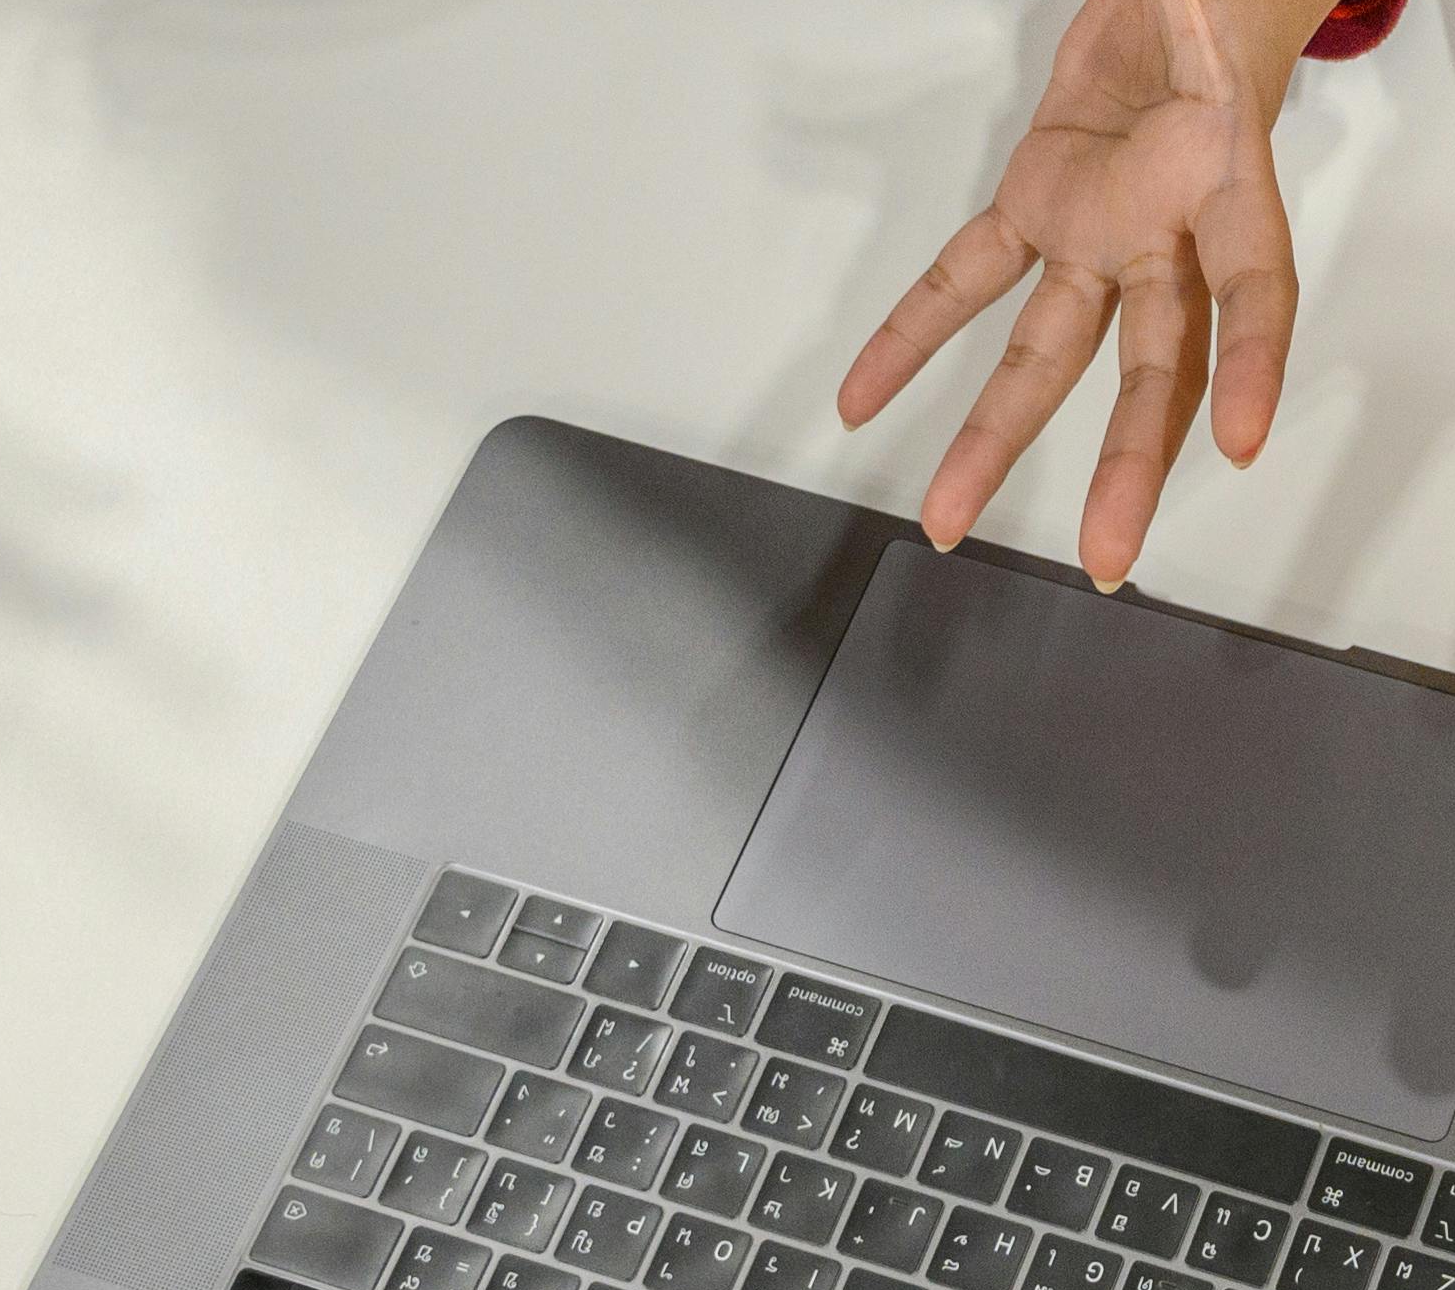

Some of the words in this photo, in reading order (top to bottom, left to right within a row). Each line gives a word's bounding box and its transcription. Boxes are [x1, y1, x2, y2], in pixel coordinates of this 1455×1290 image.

[705, 960, 756, 984] option
[786, 985, 864, 1017] command
[594, 1017, 616, 1038] ฝ
[769, 1070, 790, 1089] ม
[516, 1083, 530, 1100] ง
[857, 1096, 875, 1116] ท
[602, 1110, 616, 1129] ว
[892, 1108, 917, 1132] M
[411, 1144, 429, 1163] ล
[689, 1138, 709, 1157] ส
[982, 1136, 1006, 1160] N
[736, 1150, 750, 1173] L
[1334, 1150, 1414, 1183] command
[498, 1171, 517, 1191] บ
[1074, 1163, 1094, 1187] B
[816, 1176, 838, 1200] K
[1123, 1178, 1141, 1197] อ
[585, 1198, 605, 1218] ย
[1159, 1191, 1178, 1214] V
[625, 1214, 646, 1235] P
[907, 1205, 926, 1226] J
[1215, 1206, 1231, 1225] แ
[674, 1226, 692, 1246] น
[1252, 1218, 1272, 1241] C
[412, 1243, 433, 1263] ช
[712, 1238, 733, 1261] O
[992, 1231, 1016, 1255] H
[1301, 1232, 1322, 1255] ป
[763, 1254, 778, 1273] ร
[1342, 1244, 1364, 1269] X
[501, 1270, 519, 1289] ข
[806, 1267, 819, 1289] I
[1084, 1260, 1104, 1283] G
[1394, 1260, 1413, 1279] ผ
